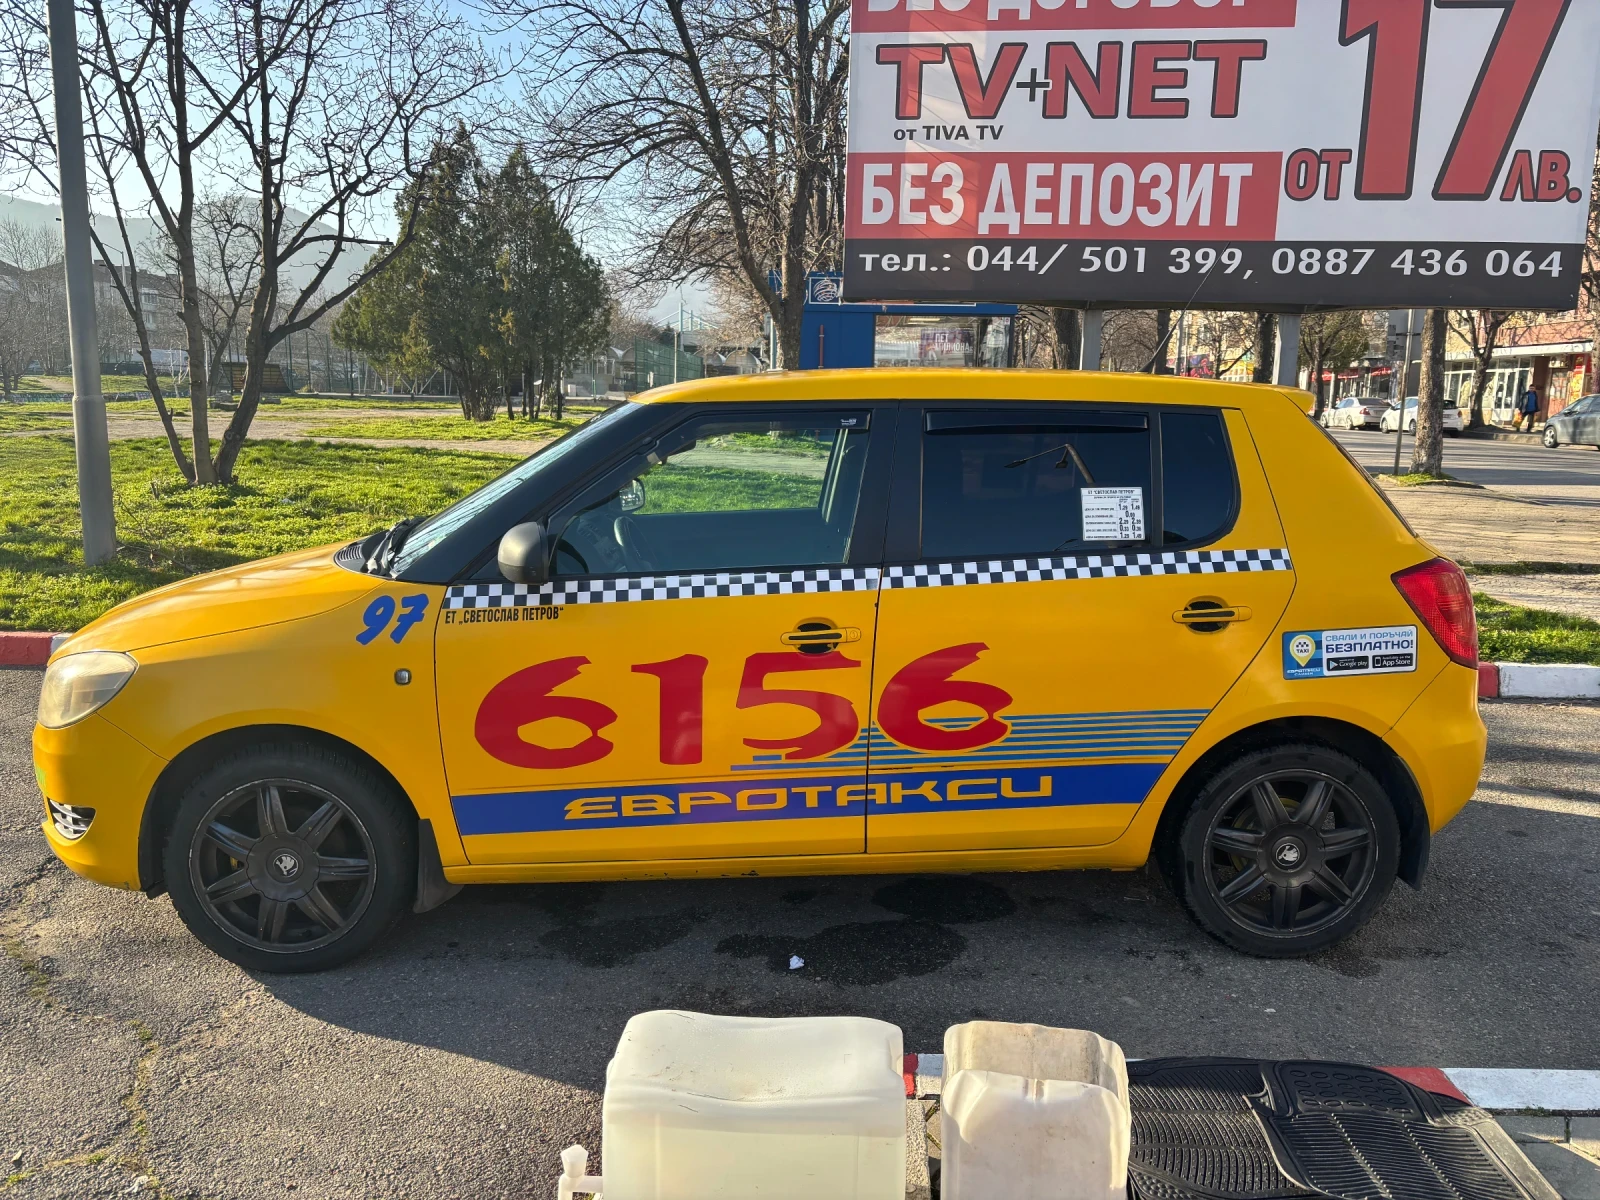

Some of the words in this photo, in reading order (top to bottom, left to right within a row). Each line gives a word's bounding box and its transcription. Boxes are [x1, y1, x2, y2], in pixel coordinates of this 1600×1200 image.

[1338, 0, 1573, 201] 17
[893, 128, 917, 141] от
[922, 126, 969, 141] TIVA
[976, 125, 1004, 141] TV
[1284, 148, 1352, 201] ОТ
[1499, 150, 1582, 203] ЛВ.
[861, 161, 965, 226] БЕЗ
[977, 161, 1254, 235] ДЕПОЗИТ
[859, 252, 951, 272] тел.:
[966, 244, 1068, 275] 044/
[1080, 246, 1146, 273] 501
[1168, 246, 1253, 280] 399,
[1271, 247, 1376, 276] 0887
[1390, 248, 1468, 276] 436
[1485, 249, 1563, 278] 064
[355, 593, 429, 645] 97
[445, 611, 457, 624] ЕТ
[1325, 634, 1357, 642] СВАЛИ
[1369, 629, 1413, 639] ПОРЪЧАЙ
[1325, 639, 1414, 653] БЕЗПЛАТНО!
[1339, 660, 1357, 668] Google
[1357, 658, 1368, 666] play
[473, 642, 1014, 769] 6156
